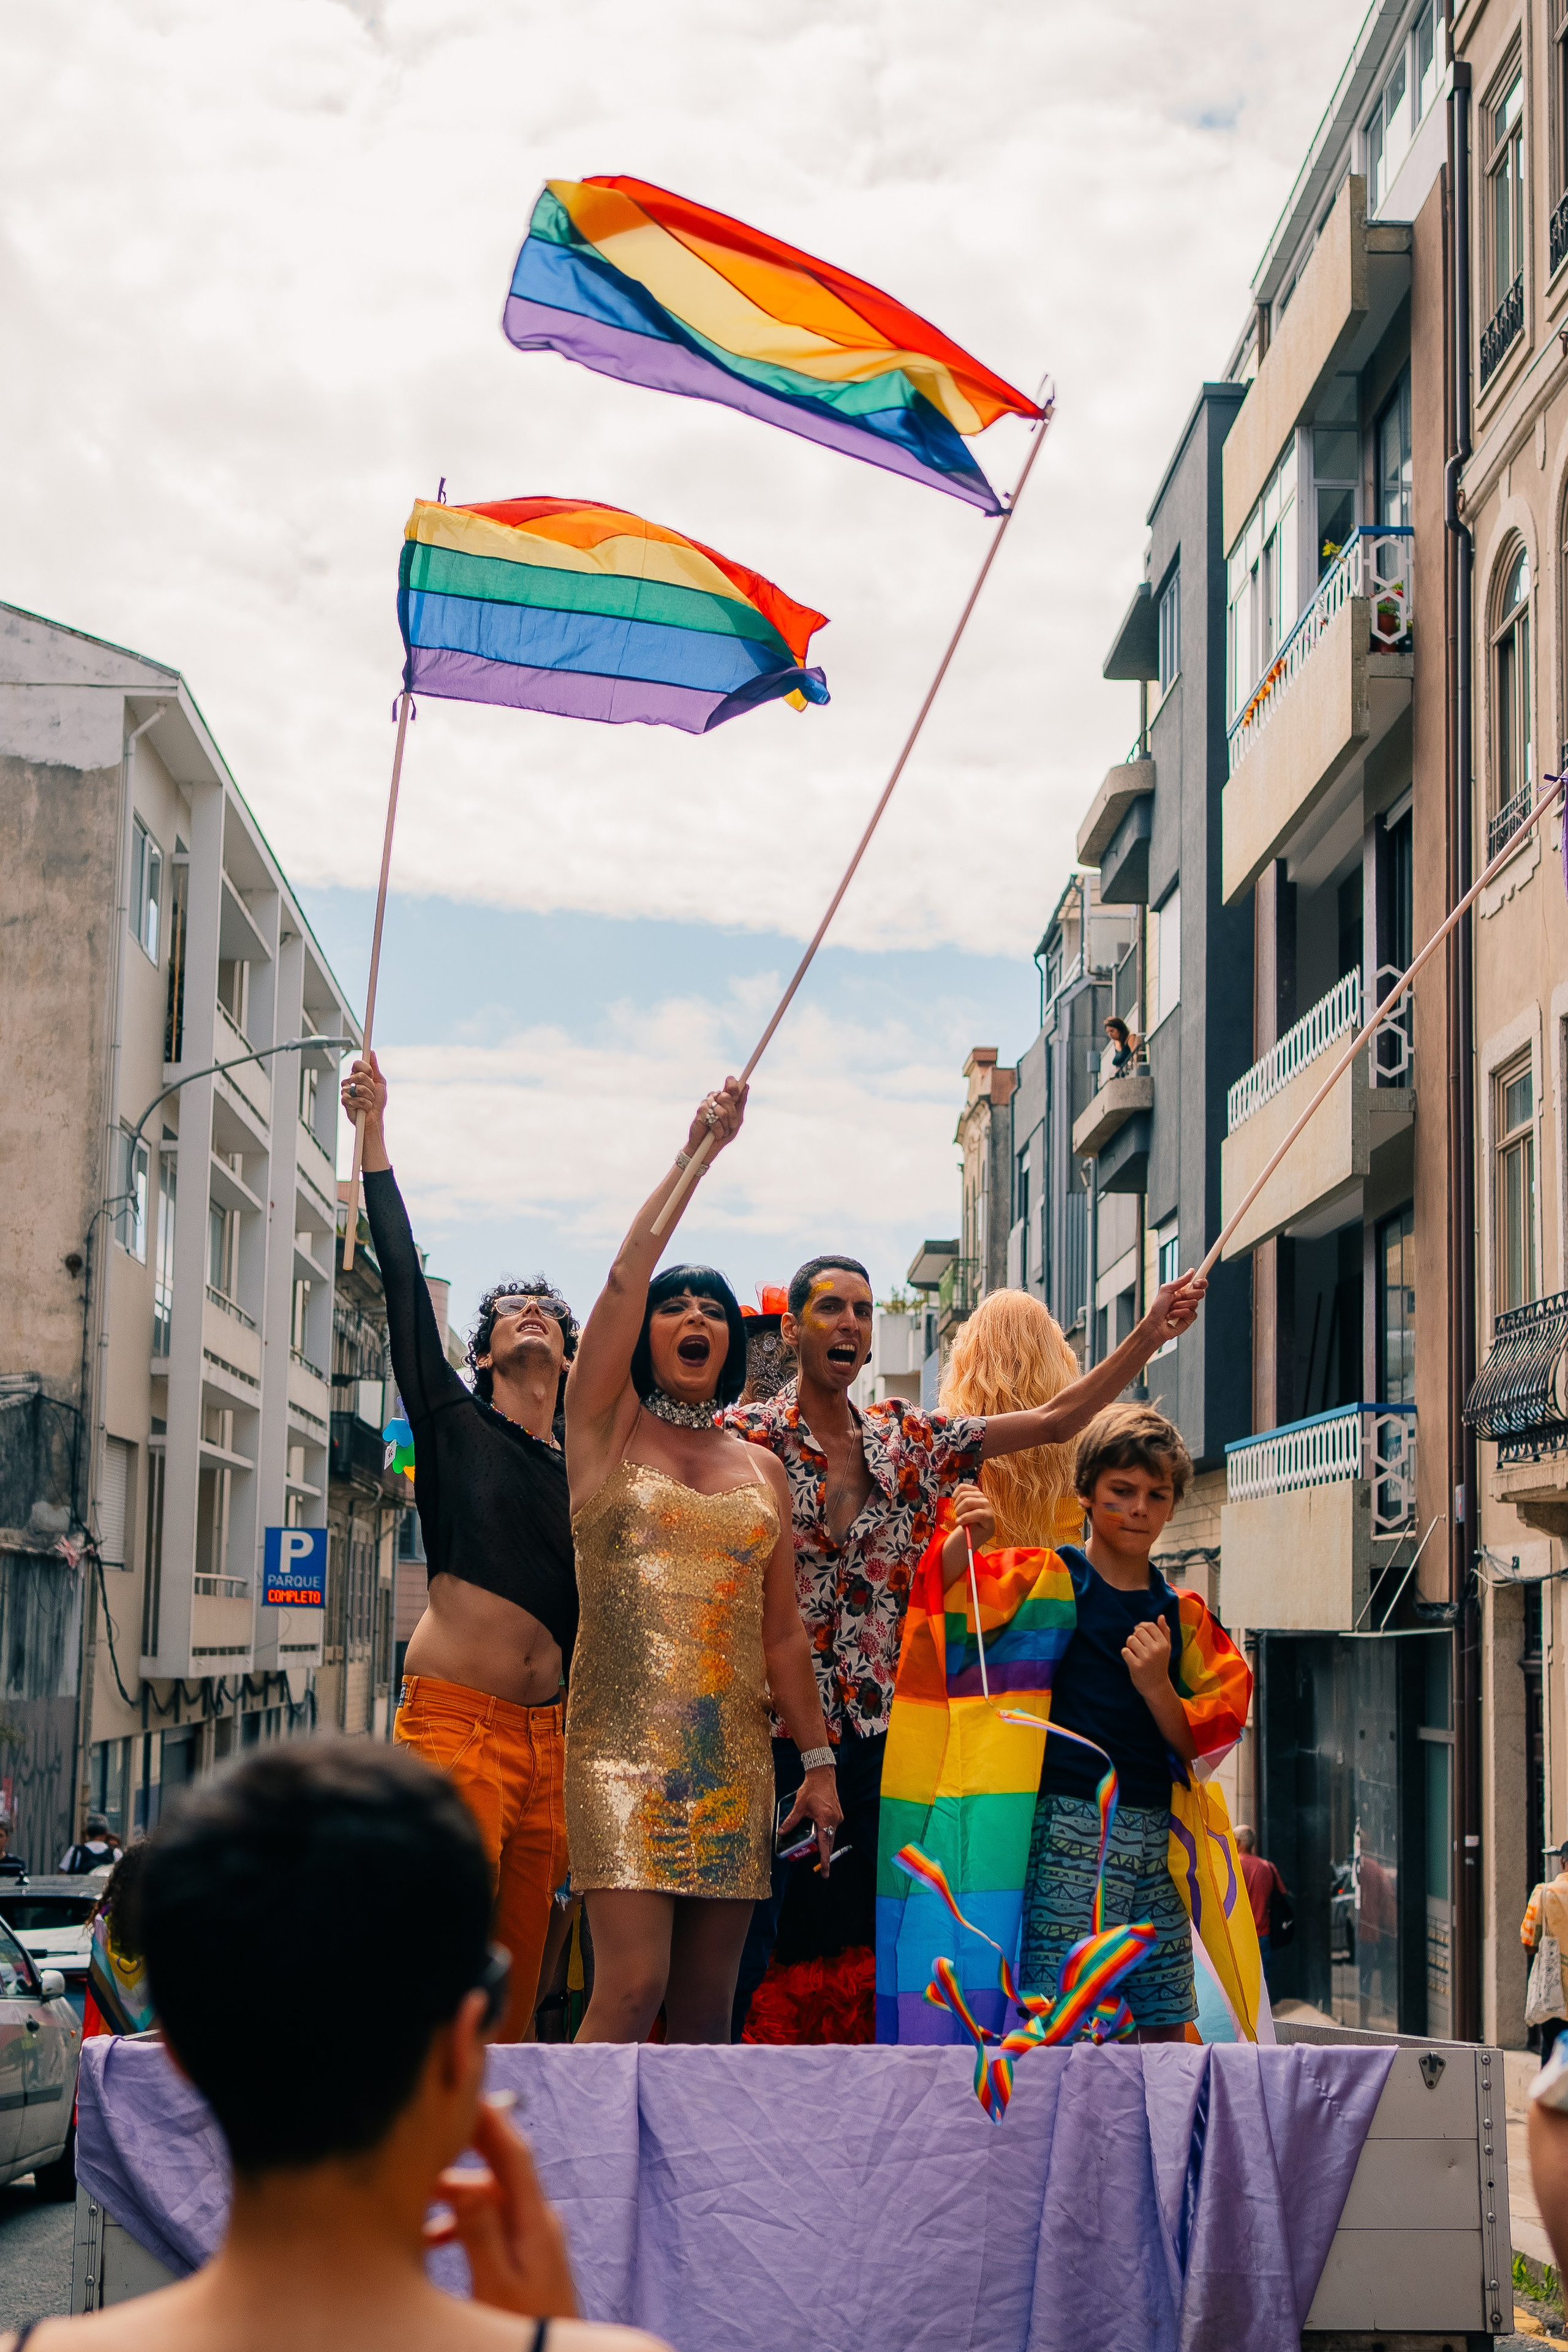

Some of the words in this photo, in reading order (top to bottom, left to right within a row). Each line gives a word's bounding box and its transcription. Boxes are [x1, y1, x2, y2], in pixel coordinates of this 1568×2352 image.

[279, 1531, 314, 1573] P
[268, 1574, 322, 1588] PARQUE
[268, 1589, 321, 1604] COMPLETO
